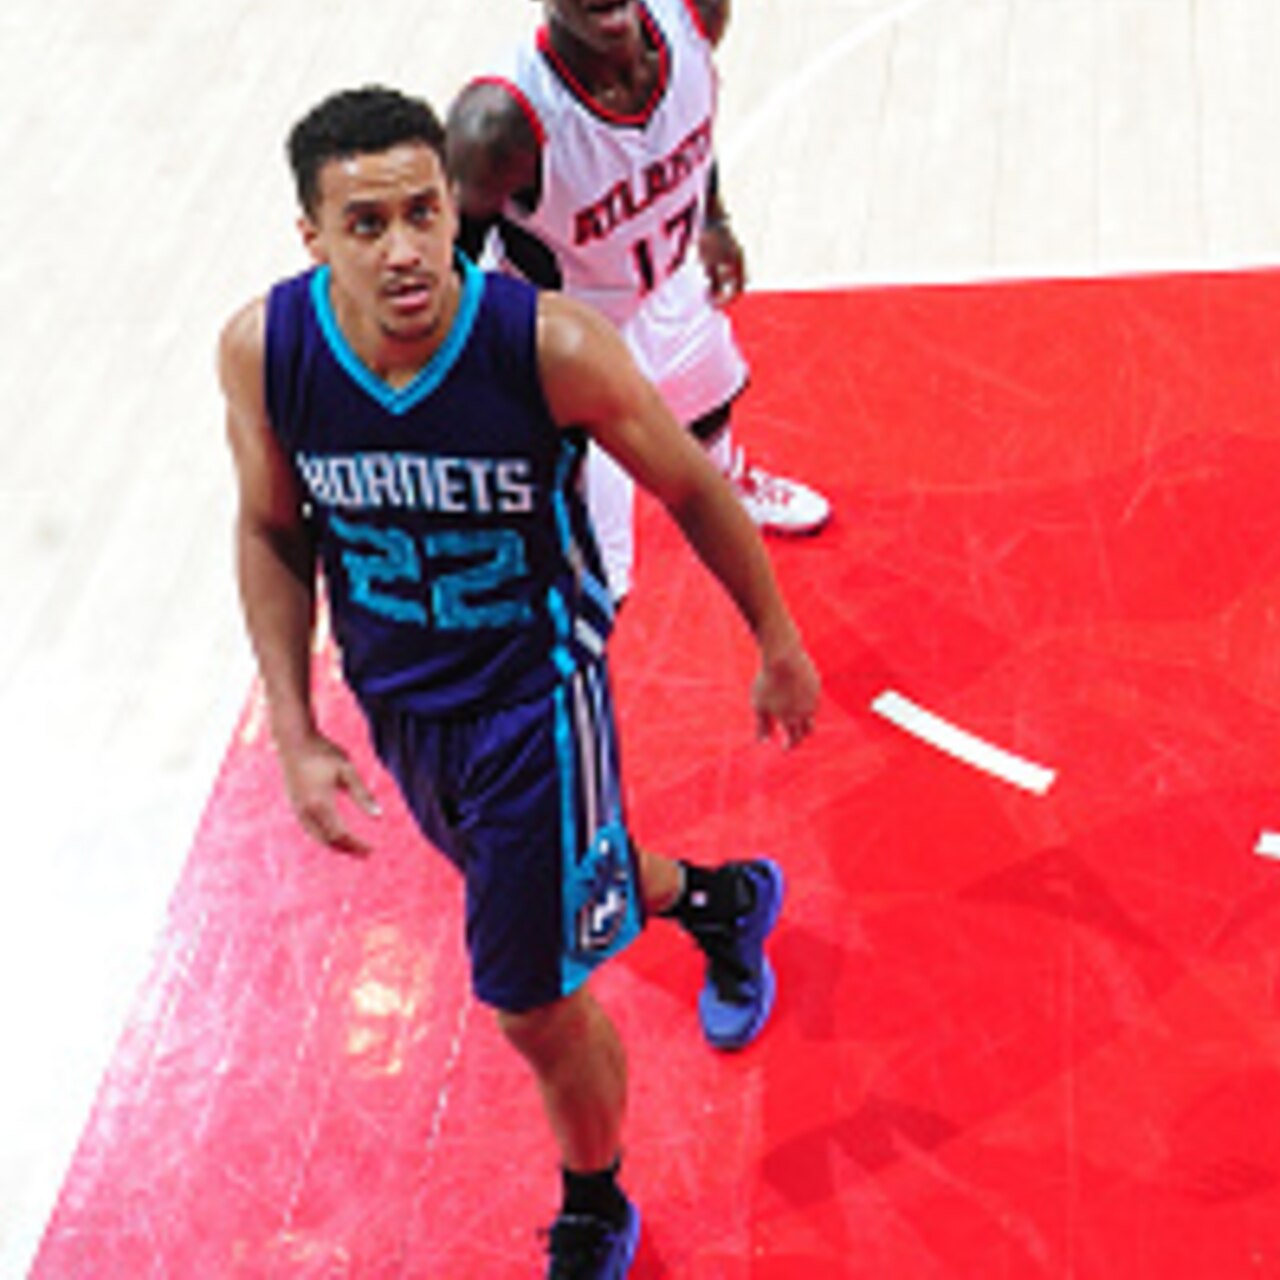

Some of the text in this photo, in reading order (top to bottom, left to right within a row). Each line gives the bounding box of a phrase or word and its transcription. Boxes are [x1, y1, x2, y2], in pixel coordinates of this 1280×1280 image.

[630, 194, 698, 301] 17
[296, 450, 534, 513] HORNETS
[328, 515, 534, 630] 22
